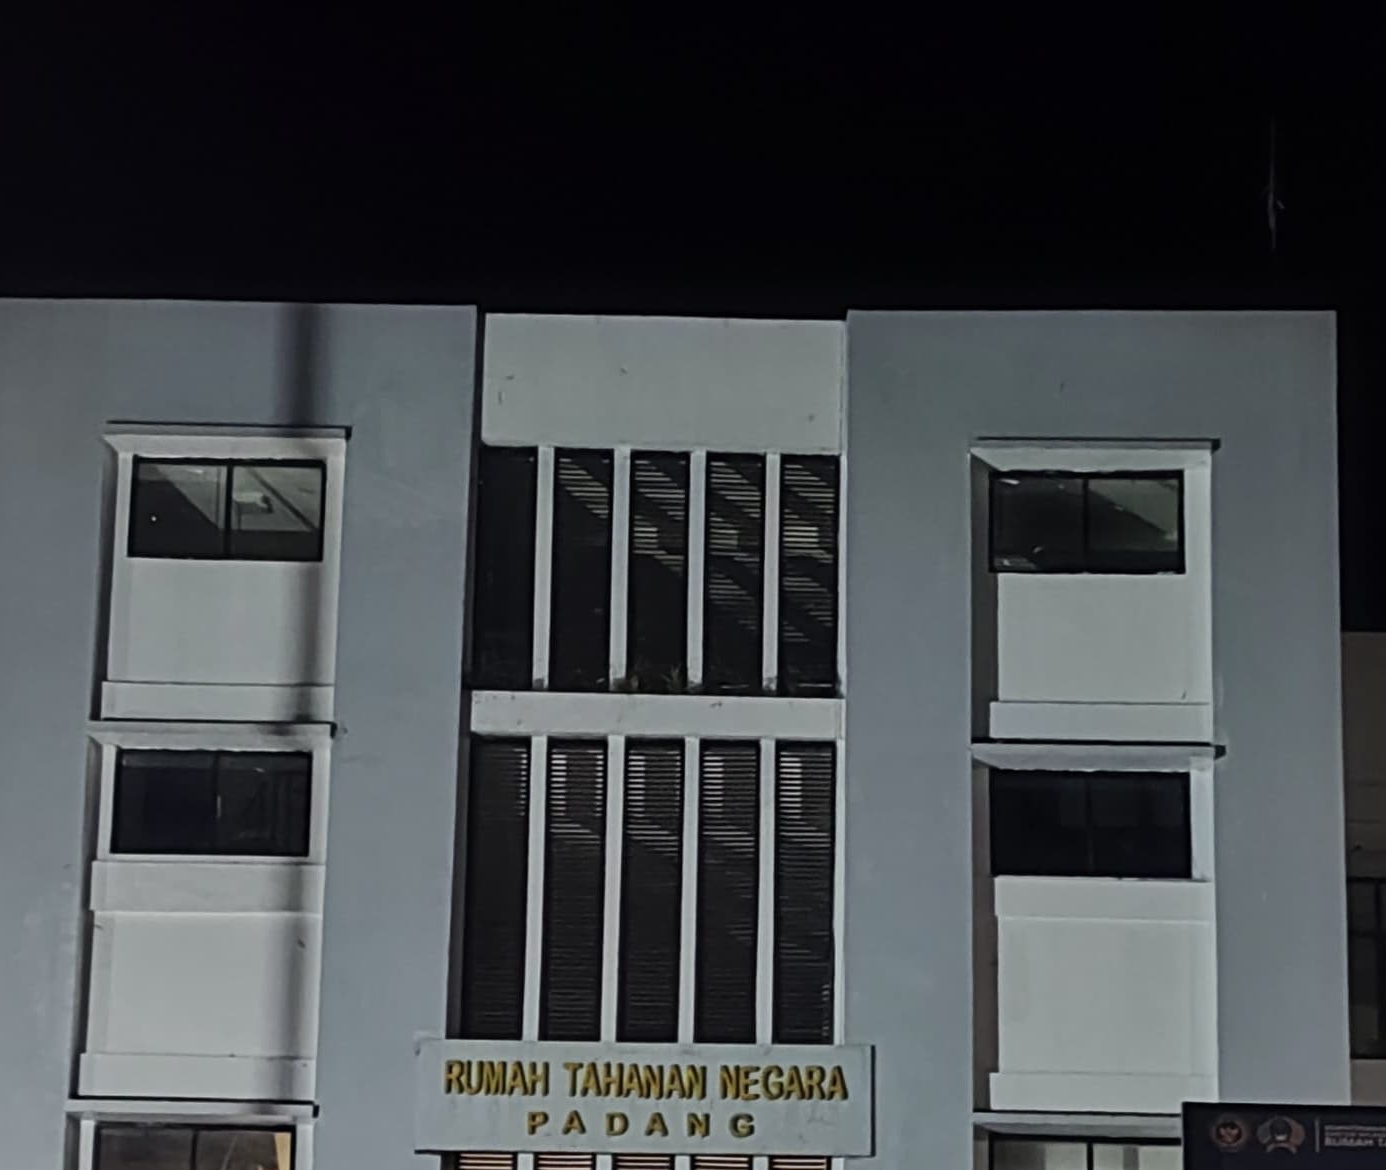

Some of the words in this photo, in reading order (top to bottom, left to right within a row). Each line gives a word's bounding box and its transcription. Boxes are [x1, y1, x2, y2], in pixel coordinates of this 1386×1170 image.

[444, 1059, 550, 1097] RUMAH
[564, 1062, 707, 1100] TAHANAN
[720, 1064, 849, 1101] NEGARA
[526, 1110, 755, 1139] PADANG
